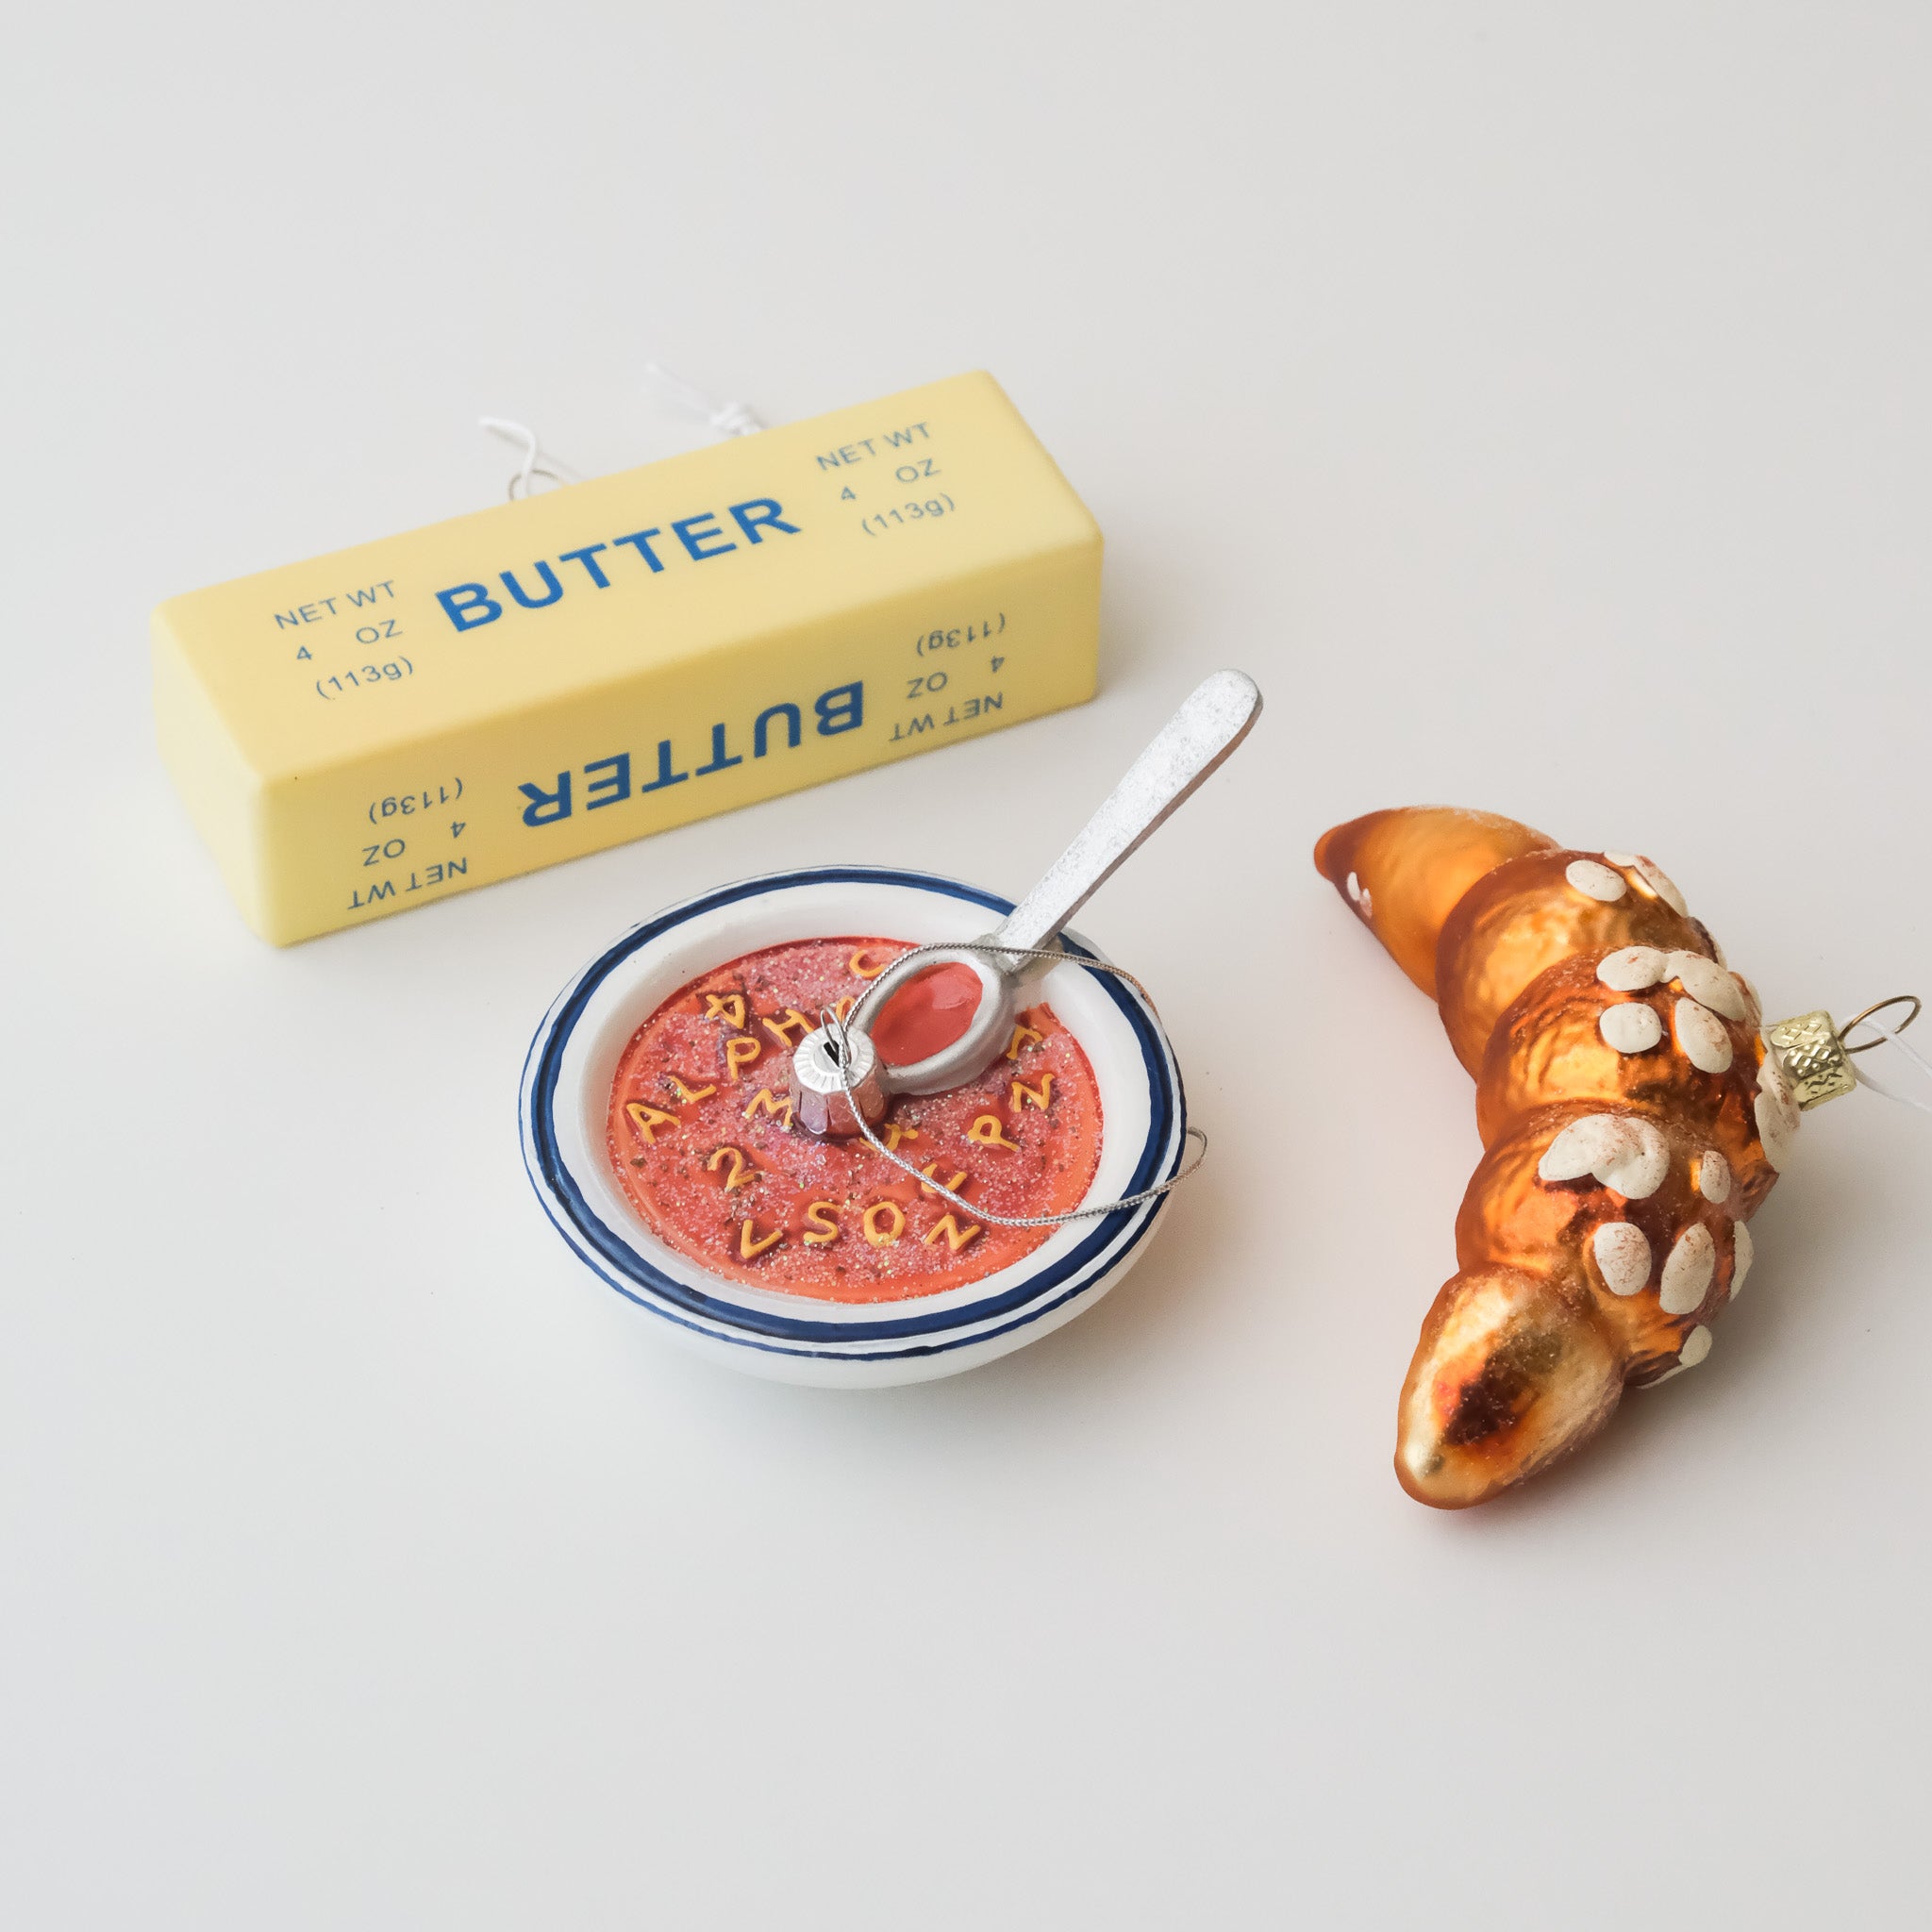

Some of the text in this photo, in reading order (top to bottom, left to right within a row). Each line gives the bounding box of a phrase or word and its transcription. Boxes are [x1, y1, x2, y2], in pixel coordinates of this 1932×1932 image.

[816, 422, 931, 473] NET WT
[840, 458, 941, 503] 4 OZ
[860, 492, 957, 538] (113g)
[434, 496, 803, 634] BUTTER
[274, 579, 398, 631] NET WT
[296, 618, 405, 662] 4 OZ
[915, 612, 1008, 658] (113g)
[314, 655, 415, 700] (113g)
[906, 655, 1008, 701] 4 OZ
[889, 691, 1006, 743] NET WT
[517, 679, 865, 829] BUTTER
[368, 776, 465, 824] (113g)
[361, 820, 468, 868] 4 OZ
[347, 857, 469, 911] NET WT
[626, 1102, 681, 1145] A
